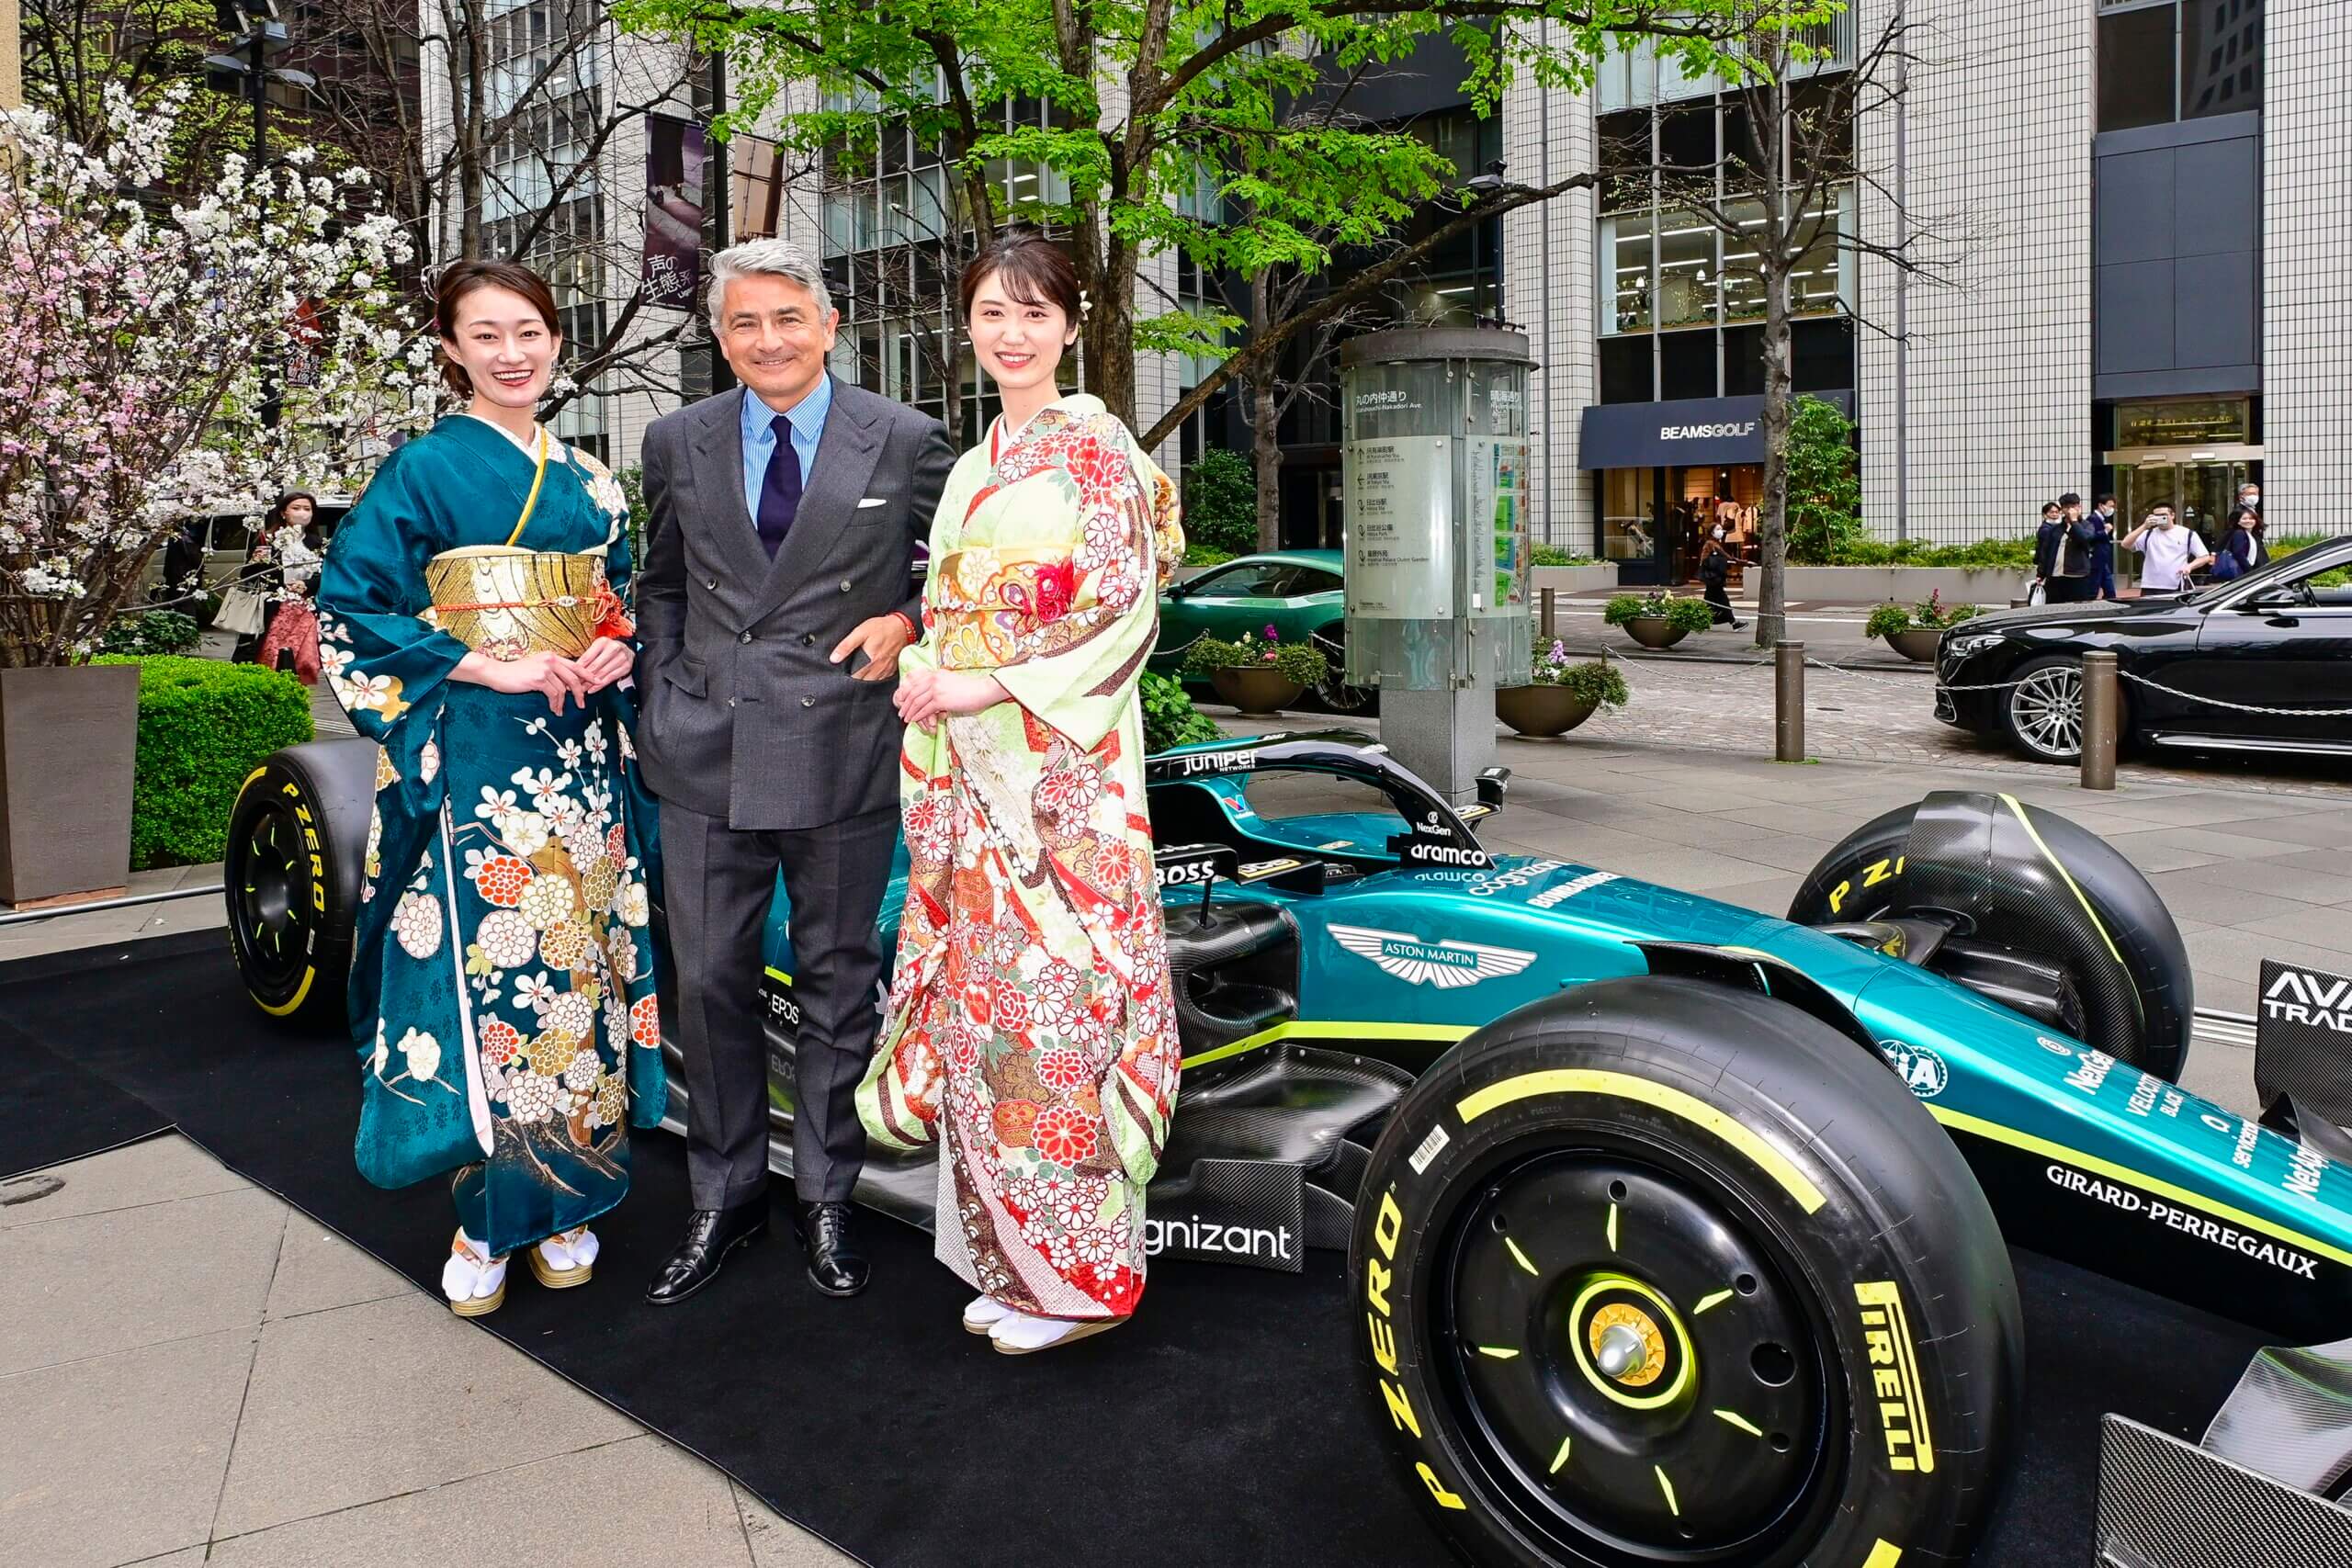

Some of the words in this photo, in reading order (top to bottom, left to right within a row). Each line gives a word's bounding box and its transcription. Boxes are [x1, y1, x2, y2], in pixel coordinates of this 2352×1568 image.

[647, 254, 679, 278] 声の
[640, 269, 692, 303] 生態系
[1355, 389, 1407, 406] 丸の内仲通り
[1660, 423, 1756, 440] BEAMSGOLF
[1219, 764, 1256, 773] NETWORKS
[1416, 821, 1452, 837] NexGen
[295, 804, 325, 912] ZERO
[1410, 843, 1487, 865] aramco
[1154, 861, 1215, 886] BOSS
[1385, 942, 1424, 958] ASTON
[1427, 951, 1474, 965] MARTIN
[2046, 1165, 2319, 1280] GIRARD-PERREGAUX
[1368, 1191, 1421, 1439] ZERO
[1853, 1281, 1934, 1473] PIRELLI
